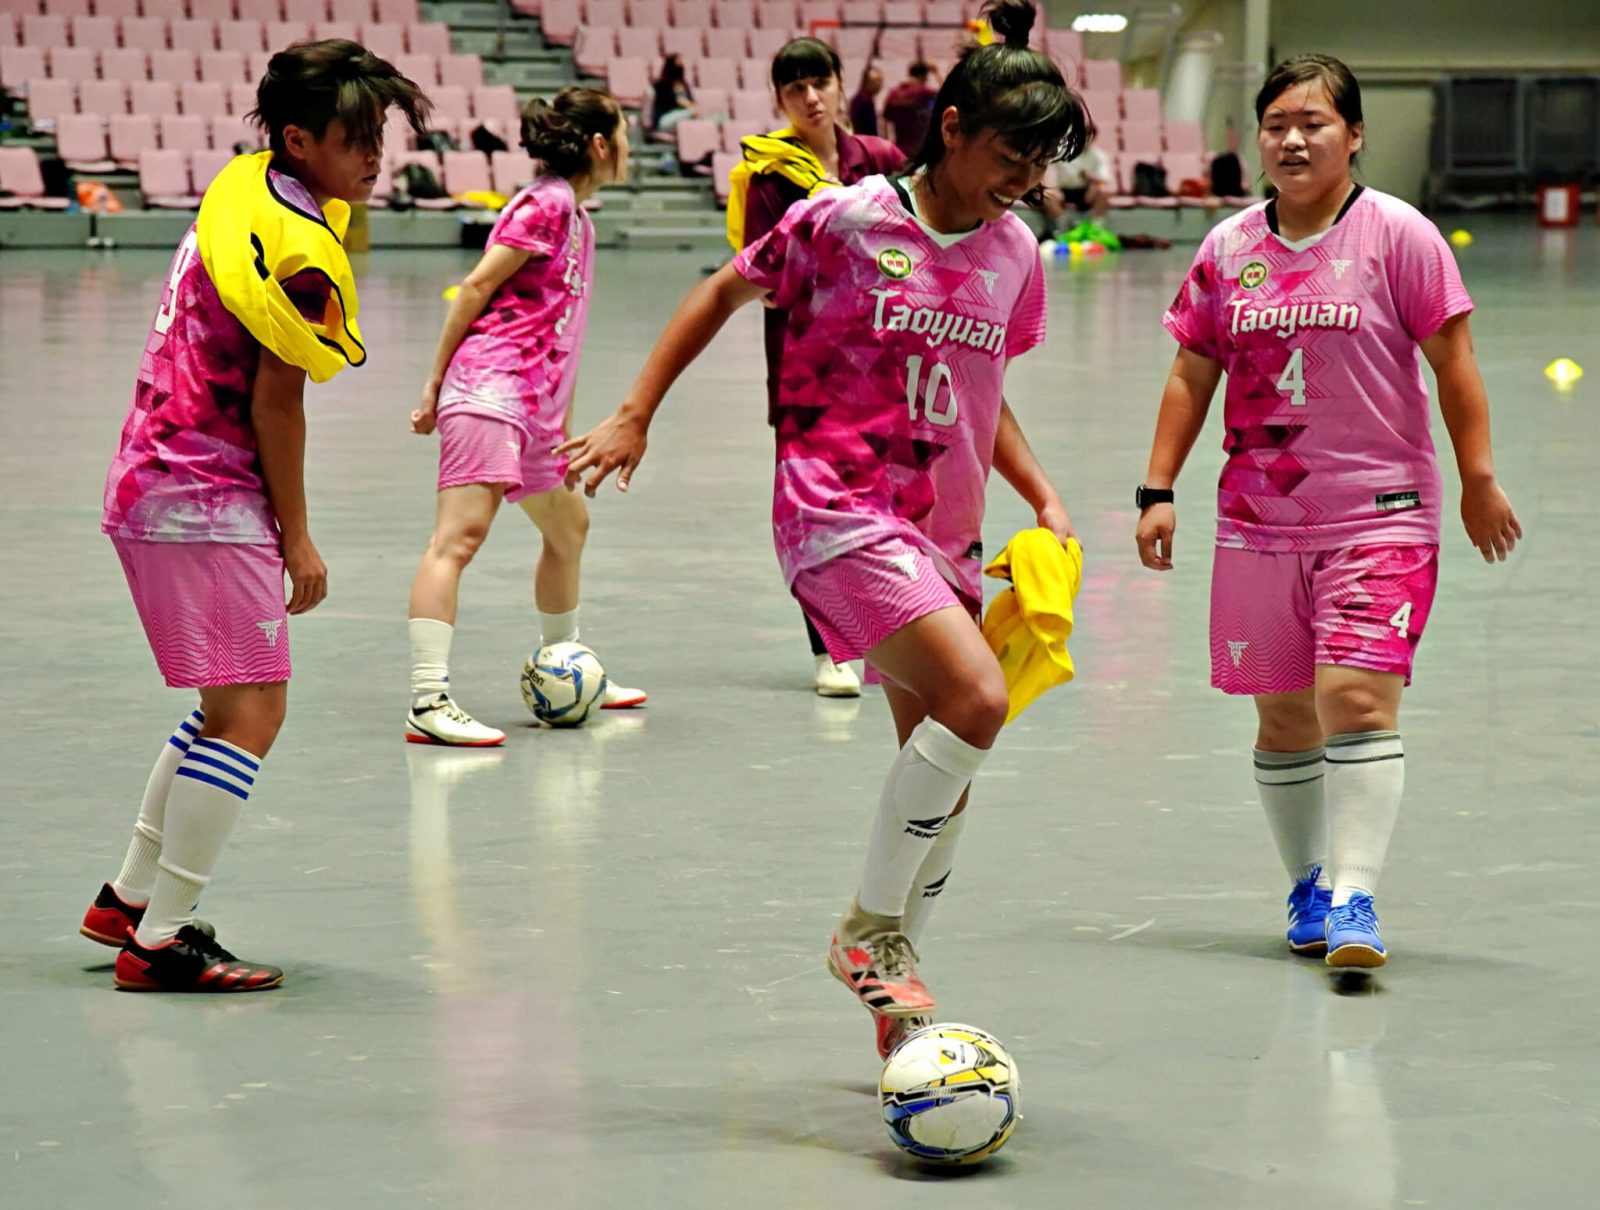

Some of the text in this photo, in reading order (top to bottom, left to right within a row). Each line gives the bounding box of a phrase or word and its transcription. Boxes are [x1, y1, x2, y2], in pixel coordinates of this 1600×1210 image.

[868, 288, 1006, 355] Taoyuan
[1229, 298, 1361, 339] Taoyuan
[905, 354, 958, 427] 10
[1276, 347, 1307, 406] 4
[1389, 601, 1412, 638] 4
